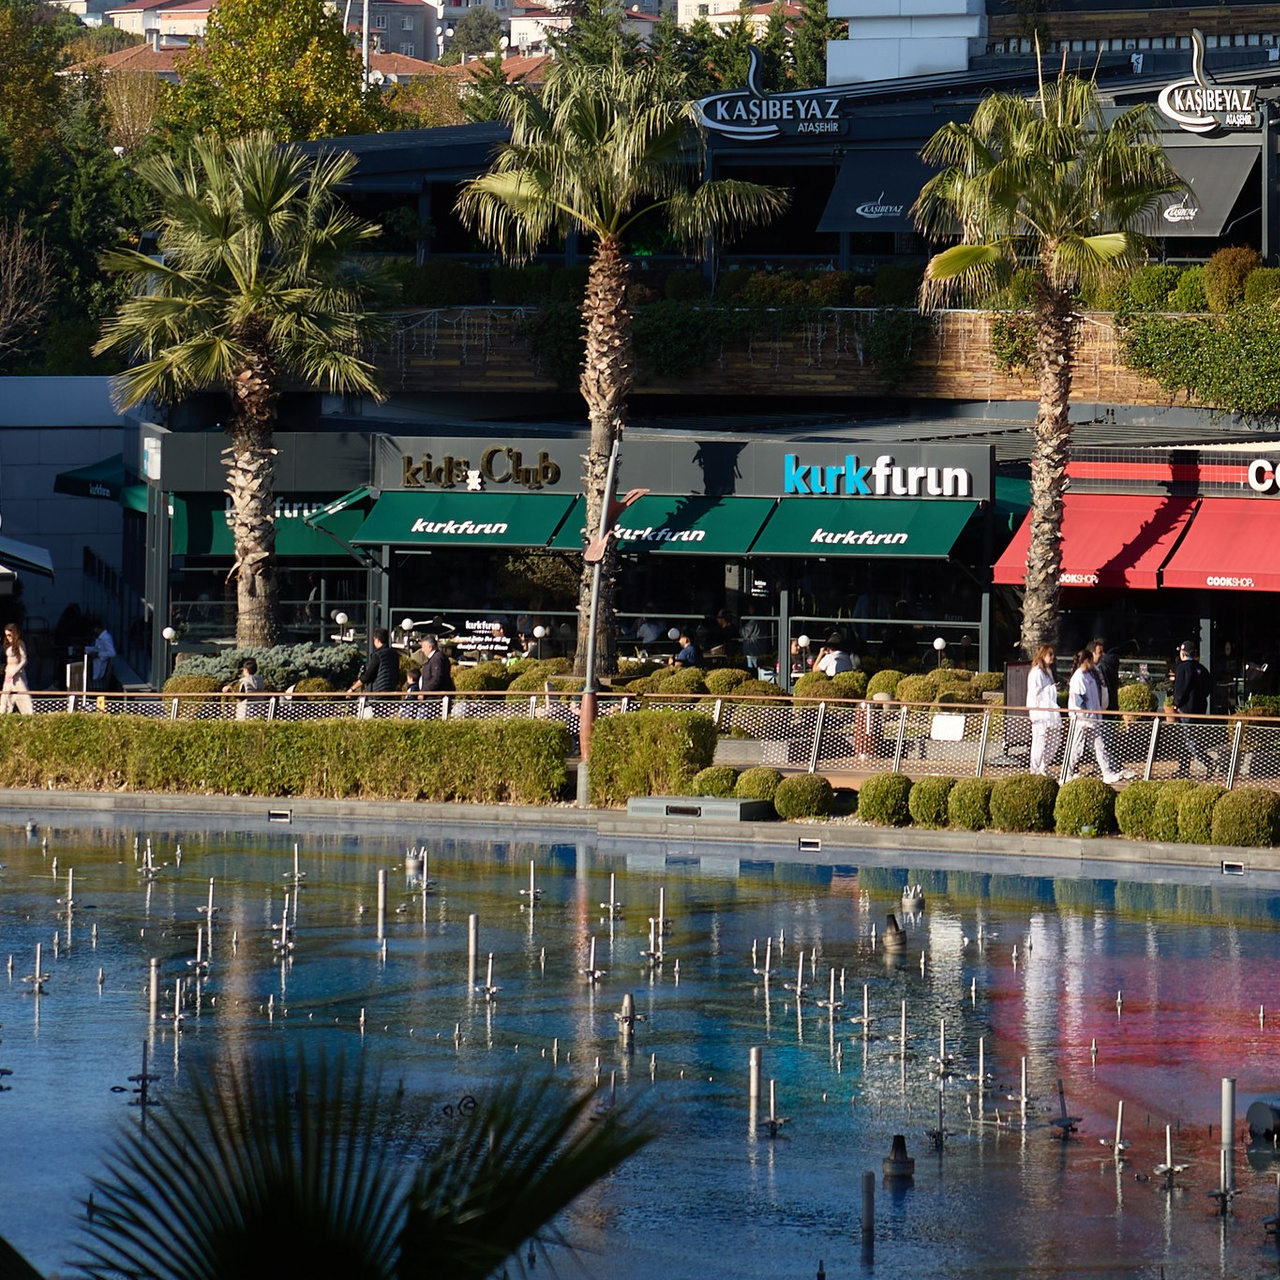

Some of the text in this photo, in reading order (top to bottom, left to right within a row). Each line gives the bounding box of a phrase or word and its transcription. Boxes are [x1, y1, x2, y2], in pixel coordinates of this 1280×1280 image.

[716, 99, 840, 125] KAŞIBEYAZ
[1174, 89, 1252, 117] KAŞIBEYAZ
[797, 120, 839, 134] ATAŞEHİR
[481, 444, 562, 488] Club
